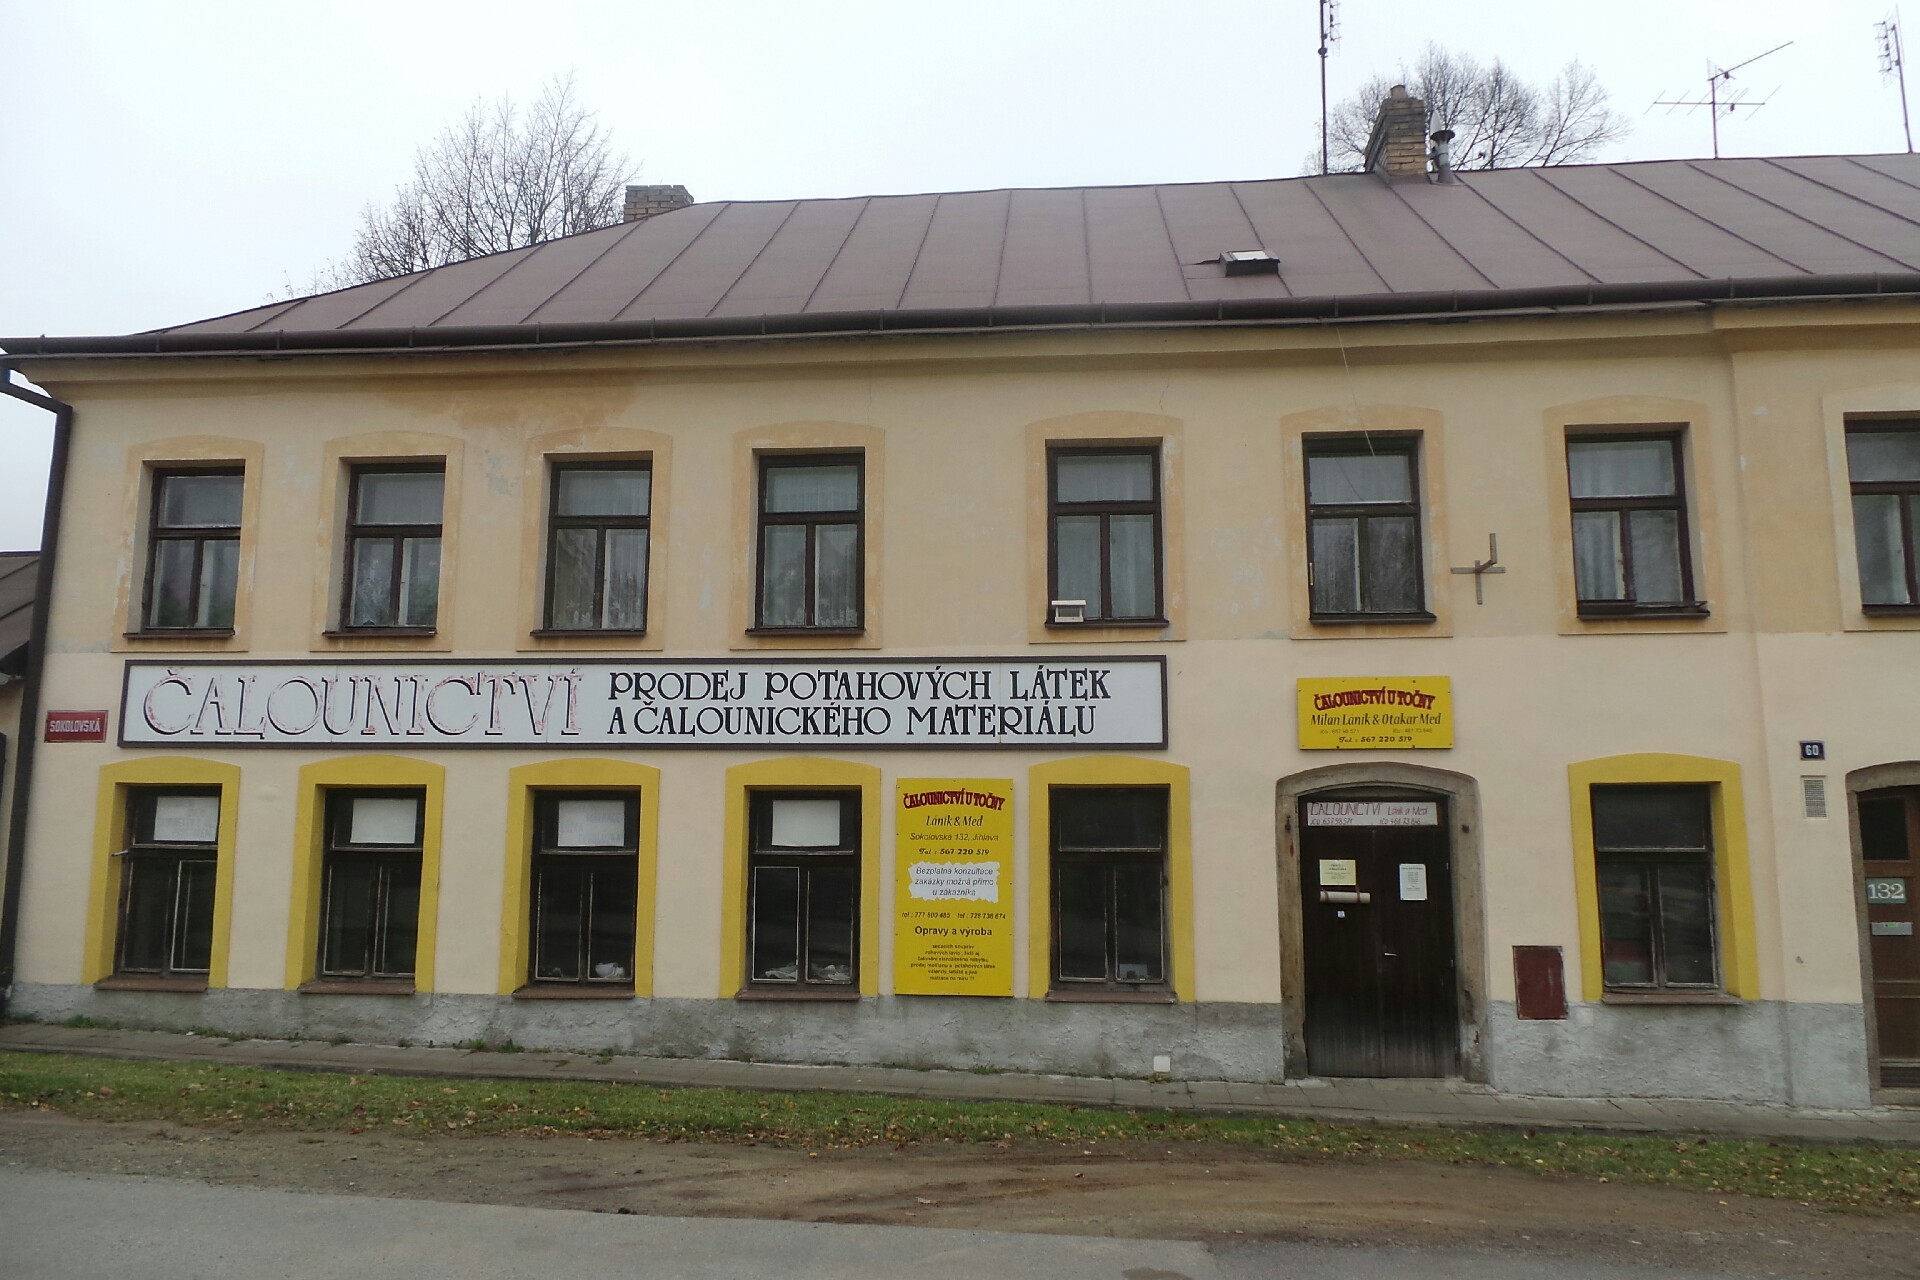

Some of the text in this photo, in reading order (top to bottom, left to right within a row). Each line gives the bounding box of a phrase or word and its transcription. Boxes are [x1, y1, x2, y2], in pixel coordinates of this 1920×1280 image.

[608, 664, 1112, 702] PRODEJ POTAHOVÝCH LÁTEK
[143, 667, 583, 740] ČALOUNICTVÍ
[1313, 686, 1436, 711] ČALOUNICTVÍ U TOČNY
[50, 717, 101, 733] SOKOLOVSKÁ
[607, 700, 1097, 737] A ČALOUNICKÉHO MATERIÁLU
[1311, 713, 1340, 726] Milan
[1372, 714, 1381, 725] &
[1381, 712, 1419, 725] Otakar
[1419, 712, 1442, 725] Med
[1805, 745, 1819, 756] 60
[903, 788, 1006, 811] ČALOUNICTVÍ U TOČNY
[953, 815, 961, 827] &
[962, 815, 984, 827] Med
[1867, 883, 1905, 900] 132
[914, 925, 949, 936] Opravy
[959, 926, 993, 937] výroba
